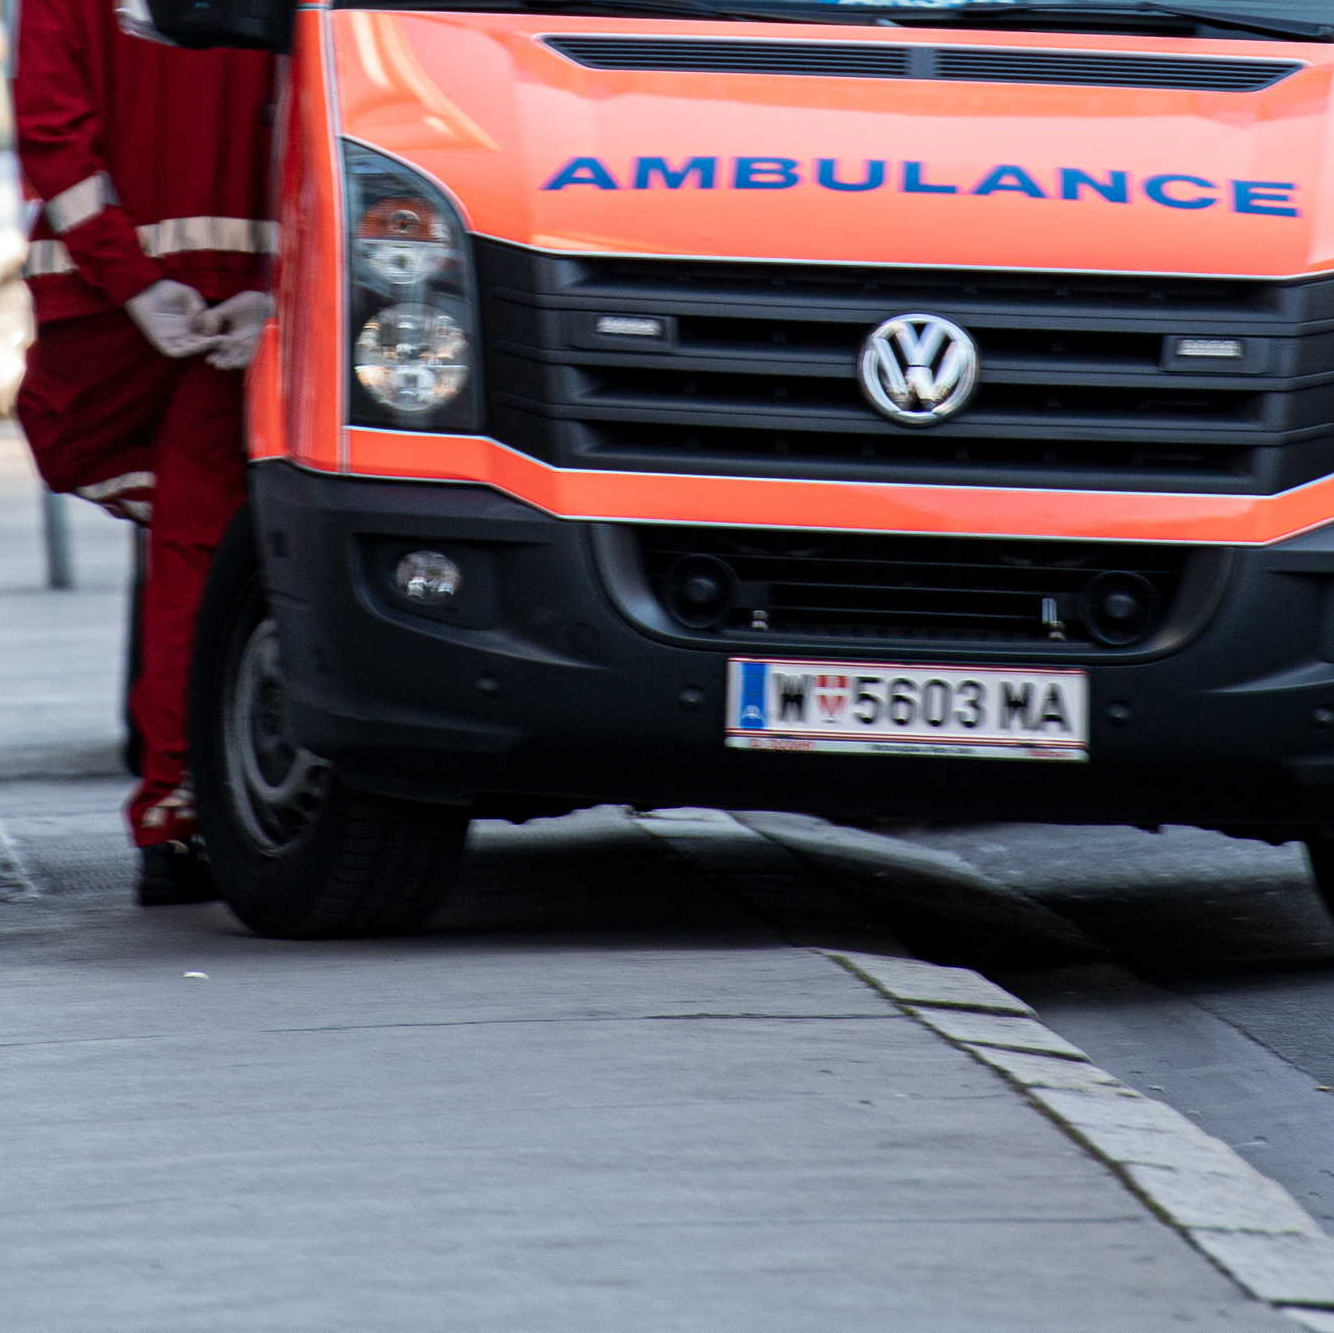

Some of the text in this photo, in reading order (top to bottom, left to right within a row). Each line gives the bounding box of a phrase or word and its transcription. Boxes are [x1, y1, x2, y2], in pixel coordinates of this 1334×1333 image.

[537, 155, 1303, 219] AMBULANCE
[773, 672, 813, 723] W
[852, 674, 988, 729] 5603
